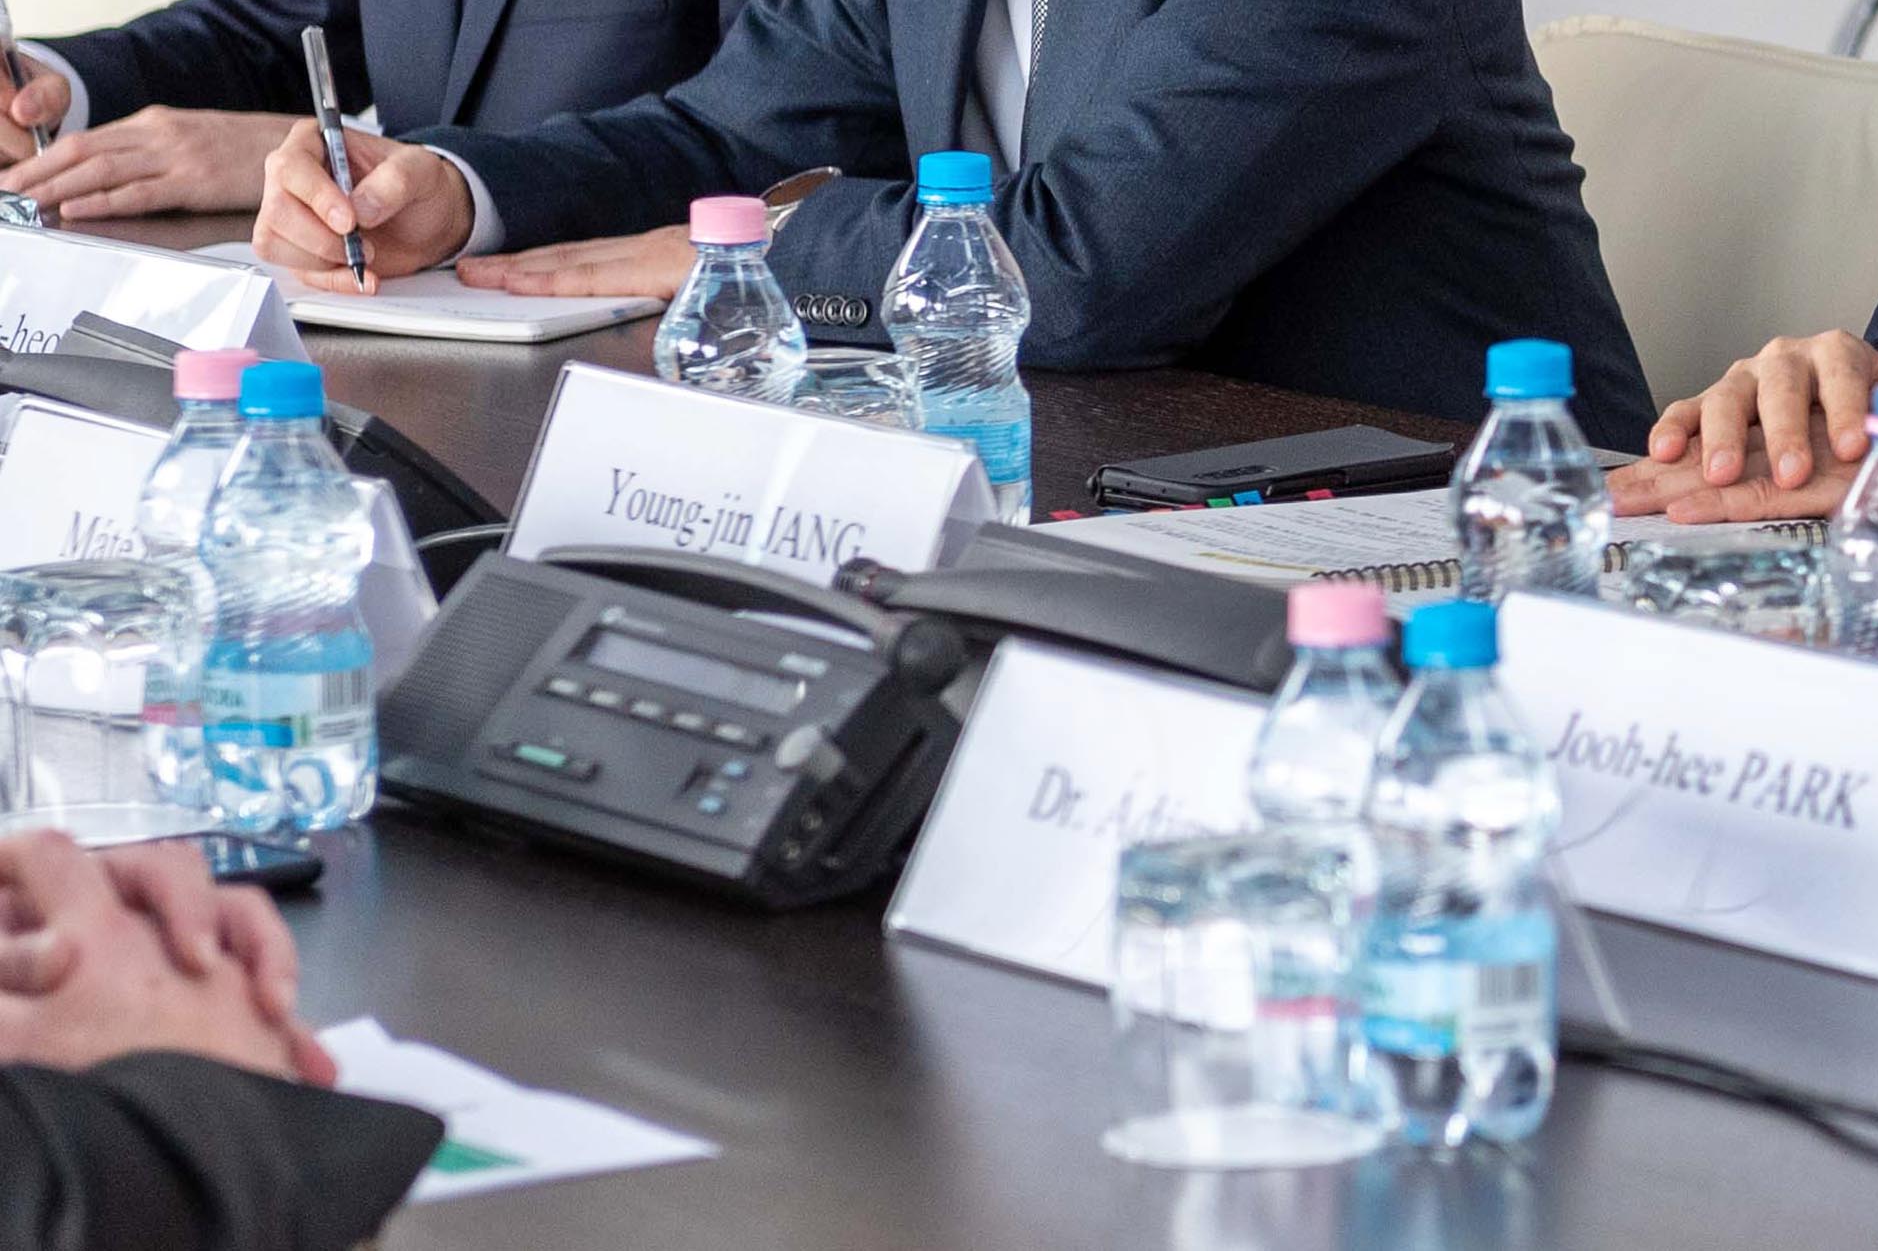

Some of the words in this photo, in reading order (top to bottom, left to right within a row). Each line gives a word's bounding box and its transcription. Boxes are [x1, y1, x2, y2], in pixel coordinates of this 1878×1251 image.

[603, 467, 755, 552] Young-jin
[761, 505, 866, 566] JANG
[1026, 762, 1087, 830] Dr.
[1728, 748, 1870, 830] PARK
